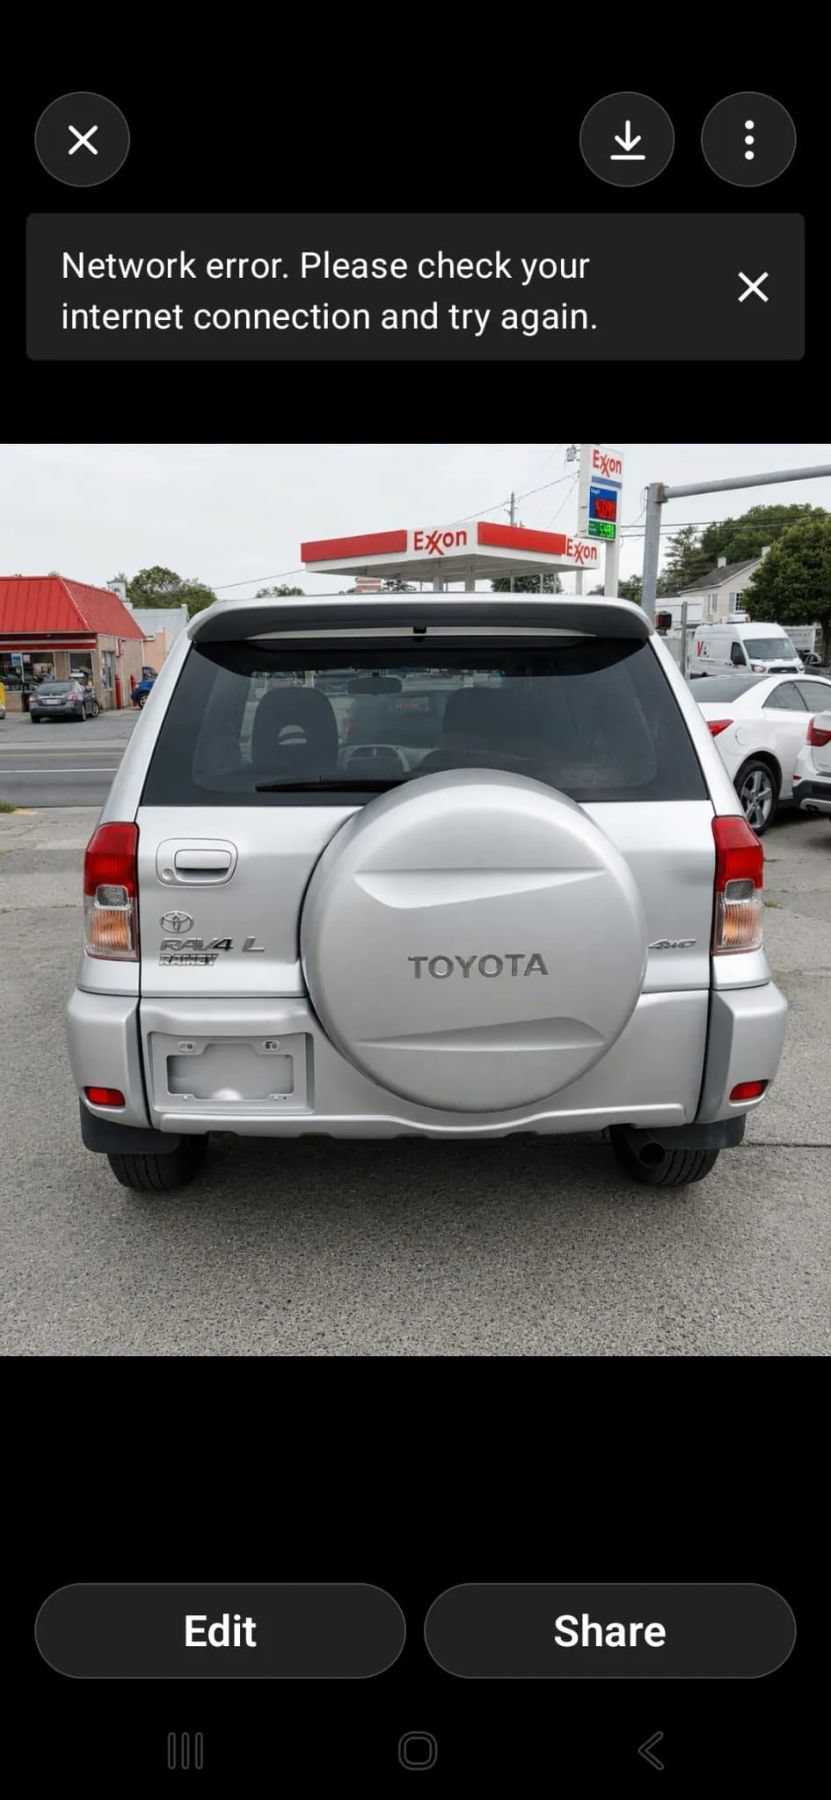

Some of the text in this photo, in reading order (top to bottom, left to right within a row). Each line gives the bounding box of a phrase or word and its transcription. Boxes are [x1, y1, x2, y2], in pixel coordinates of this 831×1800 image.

[592, 448, 622, 478] Exxon
[413, 528, 468, 555] Exxon
[566, 537, 598, 564] Exxon
[160, 936, 265, 952] RAV4 L
[407, 952, 549, 979] TOYOTA
